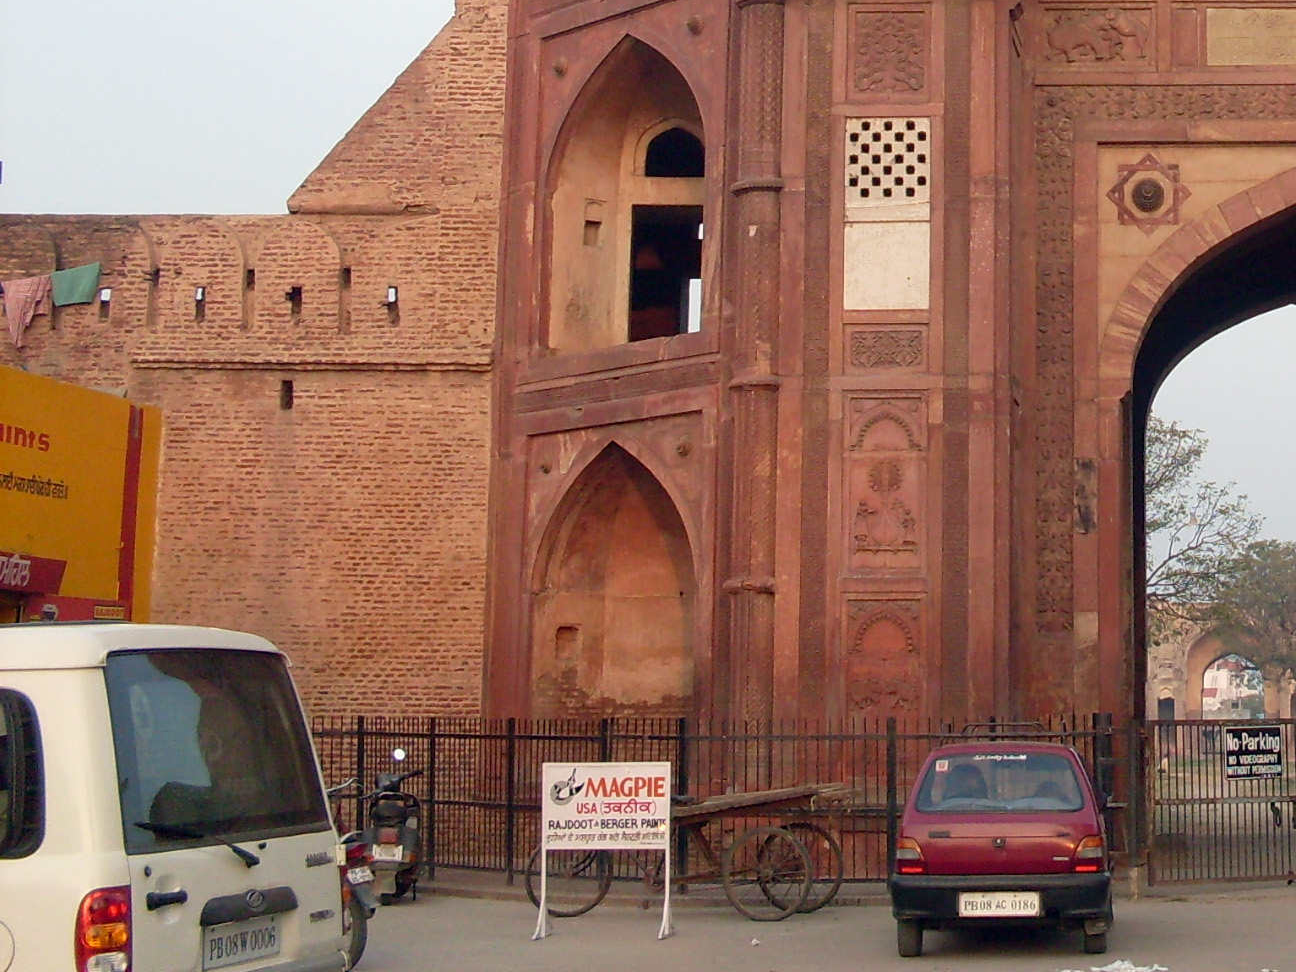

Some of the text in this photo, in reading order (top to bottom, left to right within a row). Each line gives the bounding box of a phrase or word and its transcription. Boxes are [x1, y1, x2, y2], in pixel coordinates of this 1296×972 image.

[1242, 732, 1280, 753] Parking
[1239, 754, 1278, 764] VIDEOGRAPHY
[1227, 764, 1281, 775] WITHOUT PERMISSION
[585, 776, 666, 797] MAGPIE
[577, 802, 597, 814] USA
[548, 819, 593, 830] RAJDOOT
[600, 818, 638, 830] BERGER
[995, 900, 1007, 910] AC
[1011, 899, 1036, 910] 0186
